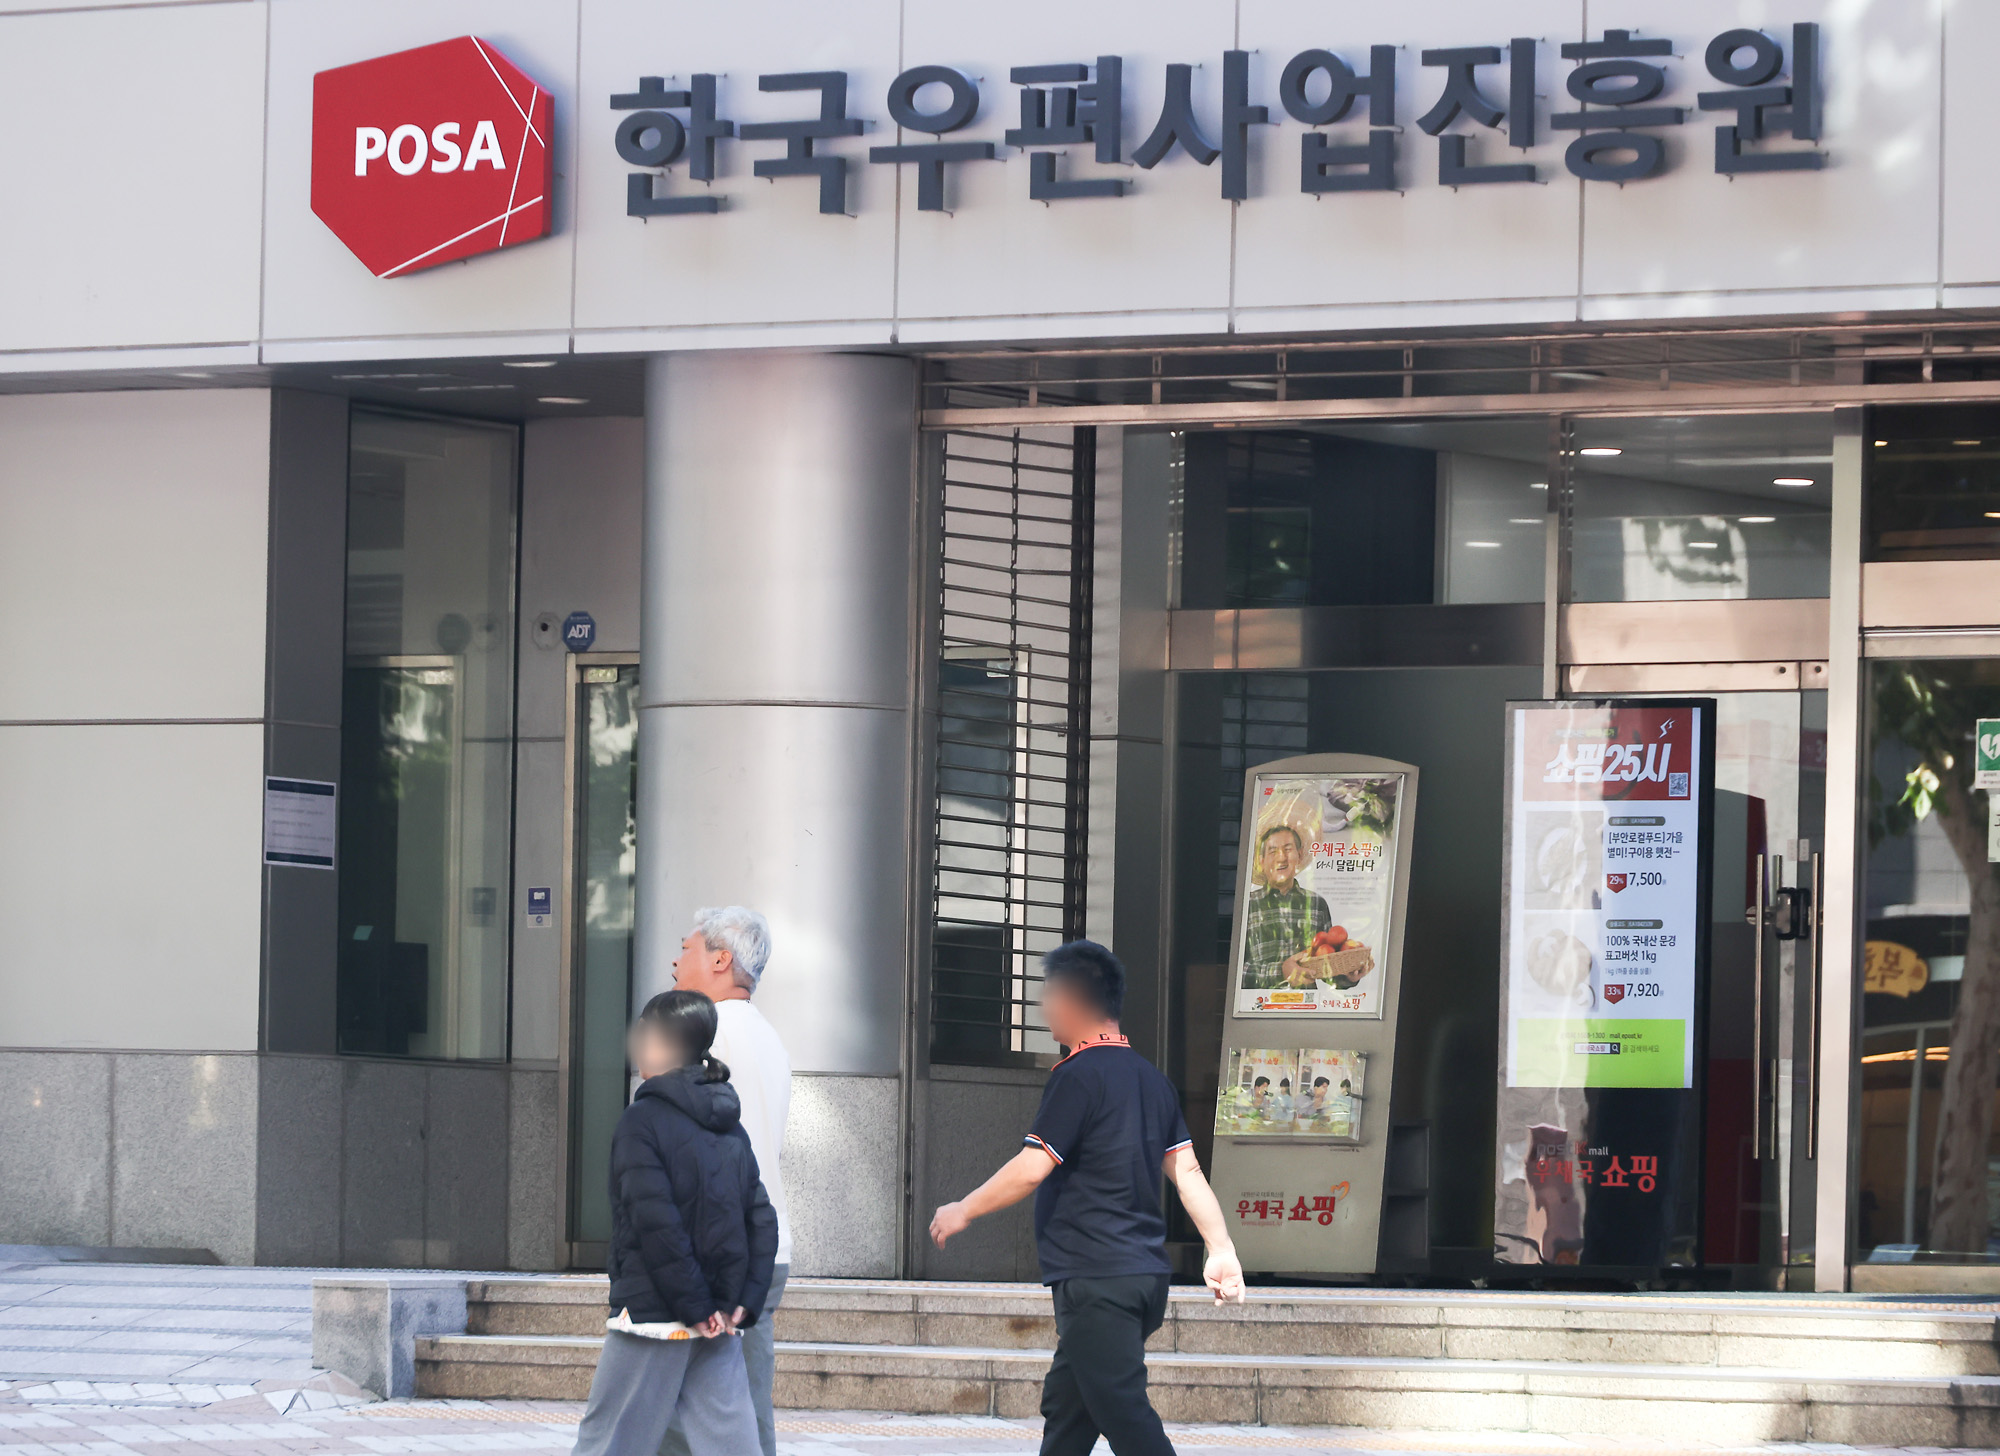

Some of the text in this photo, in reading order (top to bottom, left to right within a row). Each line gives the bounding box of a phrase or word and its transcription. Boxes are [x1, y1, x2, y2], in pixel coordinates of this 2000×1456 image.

[609, 22, 1829, 217] 한국우편사업진흥원
[354, 120, 506, 177] POSA
[567, 623, 591, 639] ADT
[1543, 743, 1672, 783] 쇼핑25시
[1309, 842, 1382, 857] 우체국 쇼핑이
[1316, 859, 1375, 872] 다시 달립니다
[1606, 935, 1676, 947] 100% 국내산 문경
[1605, 950, 1657, 963] 표고버섯 1kg
[1322, 999, 1341, 1009] 우체국
[1342, 998, 1361, 1010] 쇼핑
[1588, 1146, 1609, 1156] mall
[1533, 1155, 1658, 1193] 우체국 쇼핑
[1236, 1196, 1336, 1226] 우체국 쇼핑
